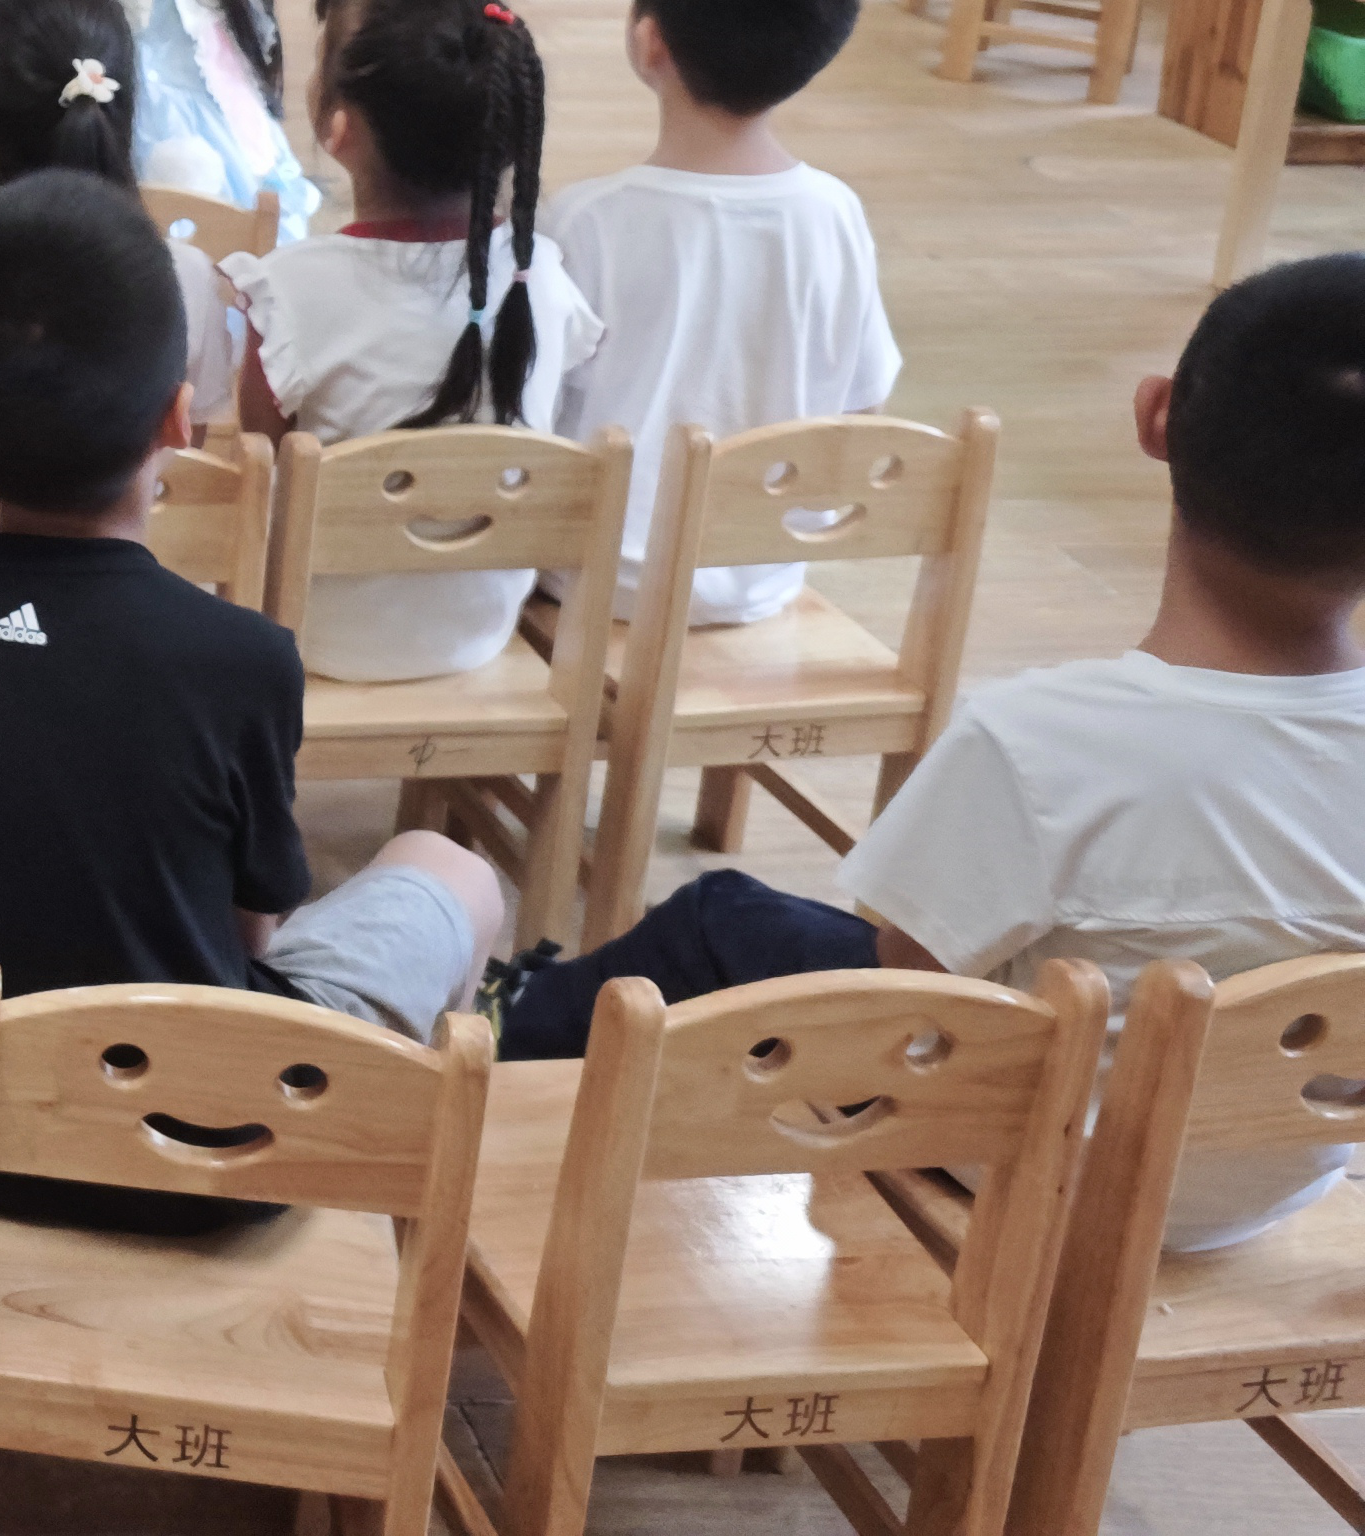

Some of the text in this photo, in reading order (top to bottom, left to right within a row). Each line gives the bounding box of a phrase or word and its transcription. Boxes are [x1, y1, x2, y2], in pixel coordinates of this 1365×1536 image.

[747, 724, 826, 759] 大班
[1235, 1359, 1349, 1413] 大班
[103, 1414, 234, 1470] 大班
[720, 1392, 840, 1443] 大班
